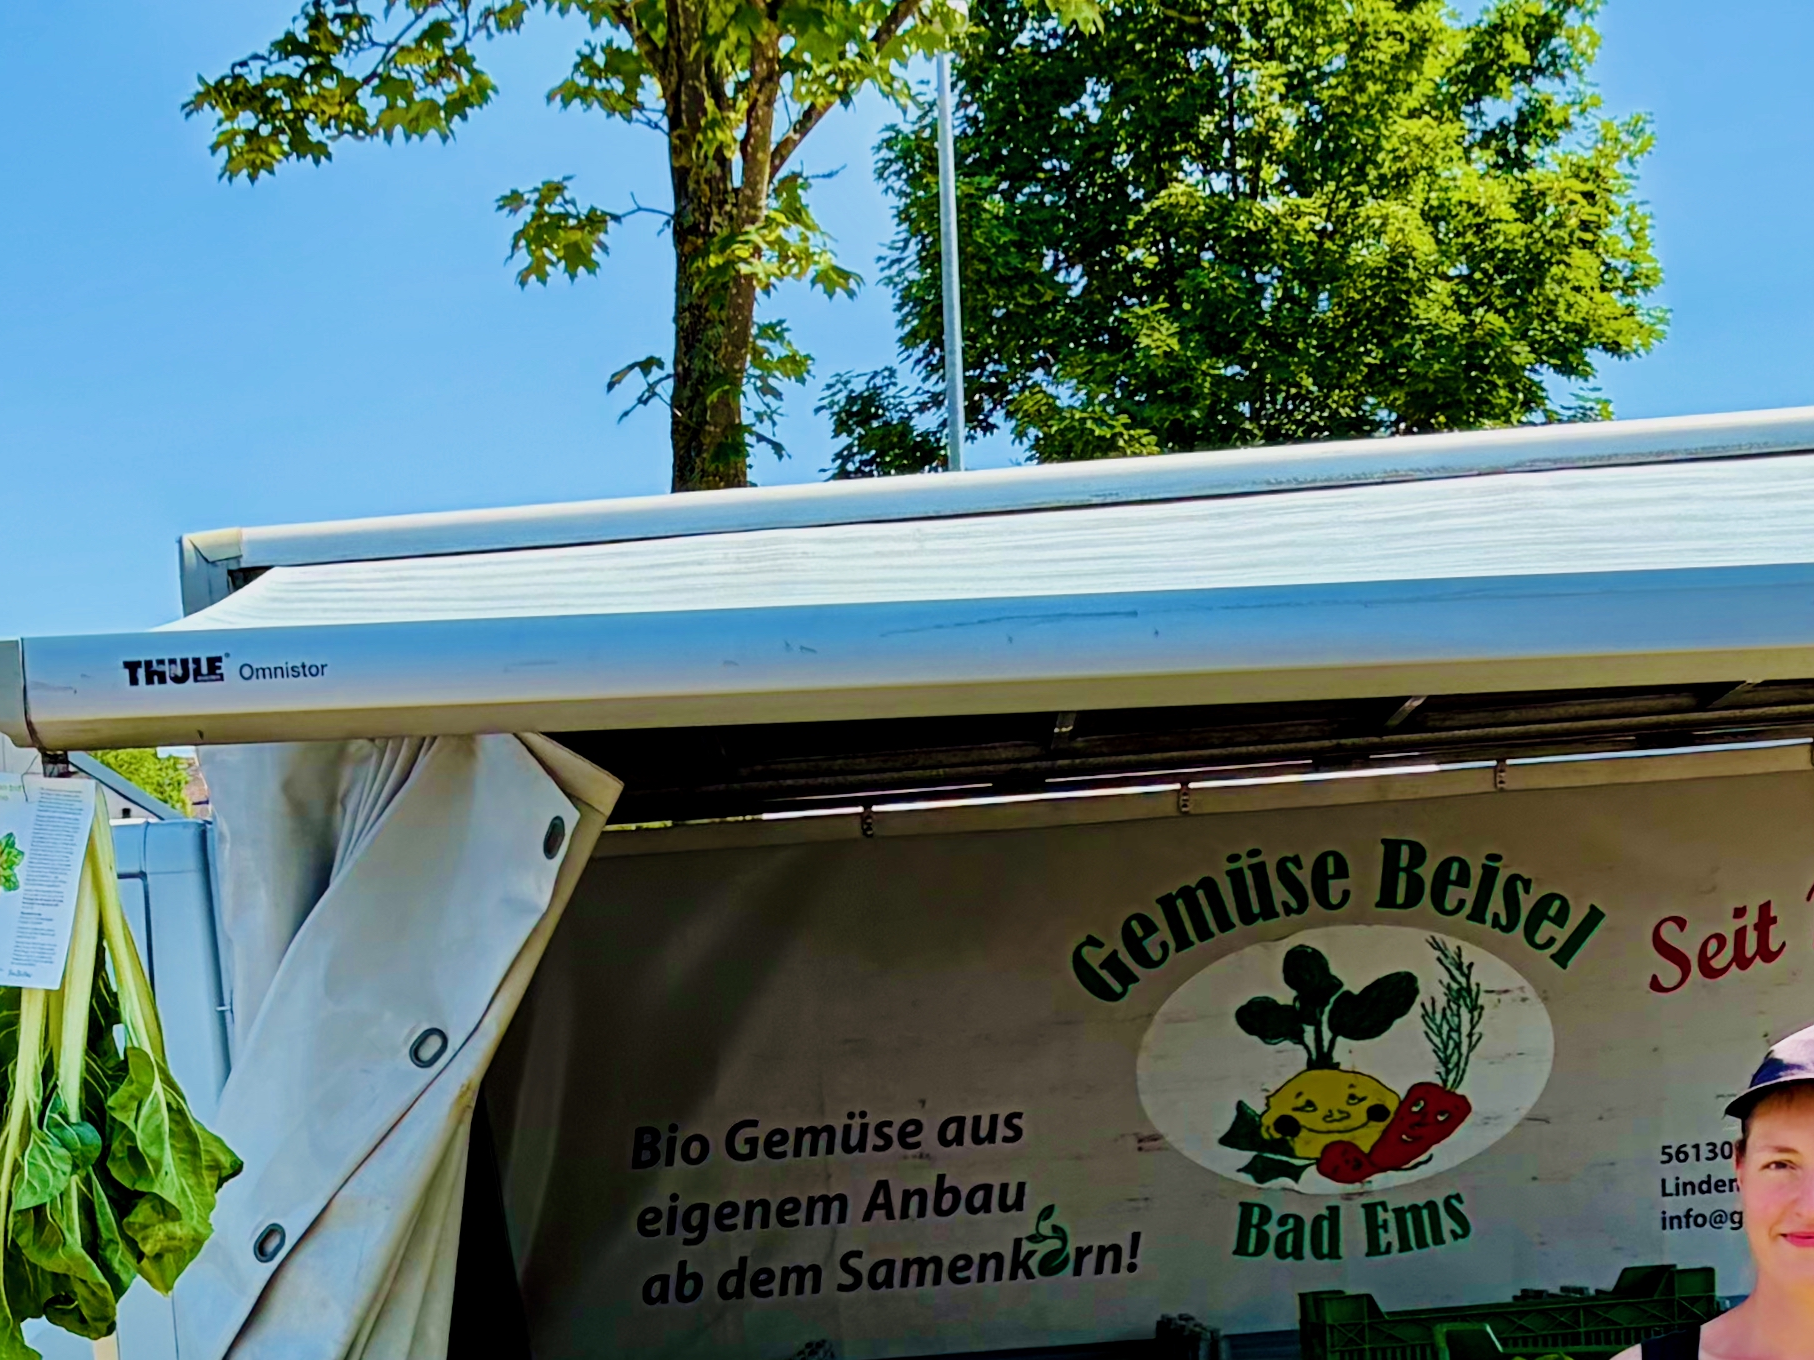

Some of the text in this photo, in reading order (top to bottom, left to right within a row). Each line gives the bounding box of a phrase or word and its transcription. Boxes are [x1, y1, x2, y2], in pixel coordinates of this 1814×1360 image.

[123, 656, 328, 686] THULE Omnistor
[1071, 837, 1606, 1003] Gemüse Beisel
[1649, 900, 1786, 994] Seit
[631, 1110, 1024, 1169] Bio Gemüse aus
[1660, 1141, 1734, 1164] 56130
[636, 1173, 1027, 1246] eigenem Anbau
[1232, 1191, 1472, 1260] Bad Ems
[641, 1222, 1142, 1306] ab dem Samenkorn!
